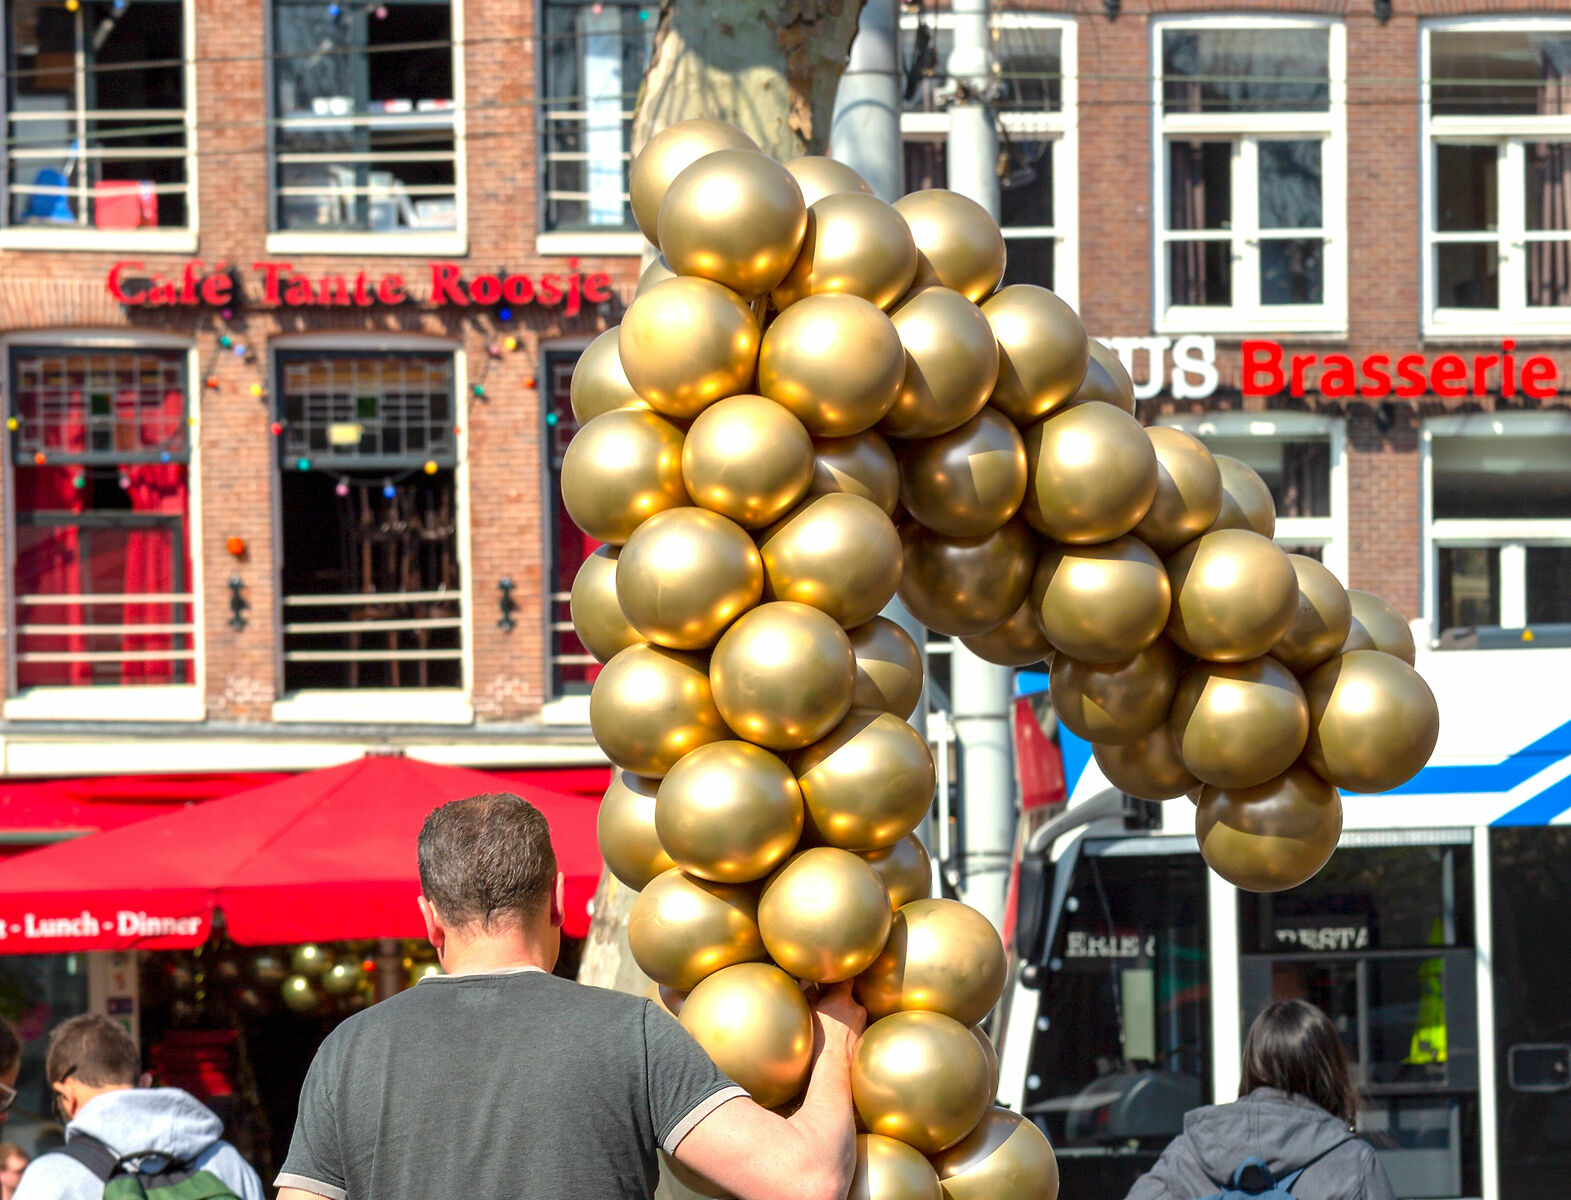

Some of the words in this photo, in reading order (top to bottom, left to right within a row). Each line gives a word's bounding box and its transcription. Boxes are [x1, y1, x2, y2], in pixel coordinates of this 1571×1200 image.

[107, 259, 234, 305] Café
[252, 261, 406, 306] Tante
[428, 256, 613, 317] Roosje
[1241, 337, 1558, 398] Brasserie
[24, 910, 100, 938] Lunch
[116, 910, 202, 937] Dinner
